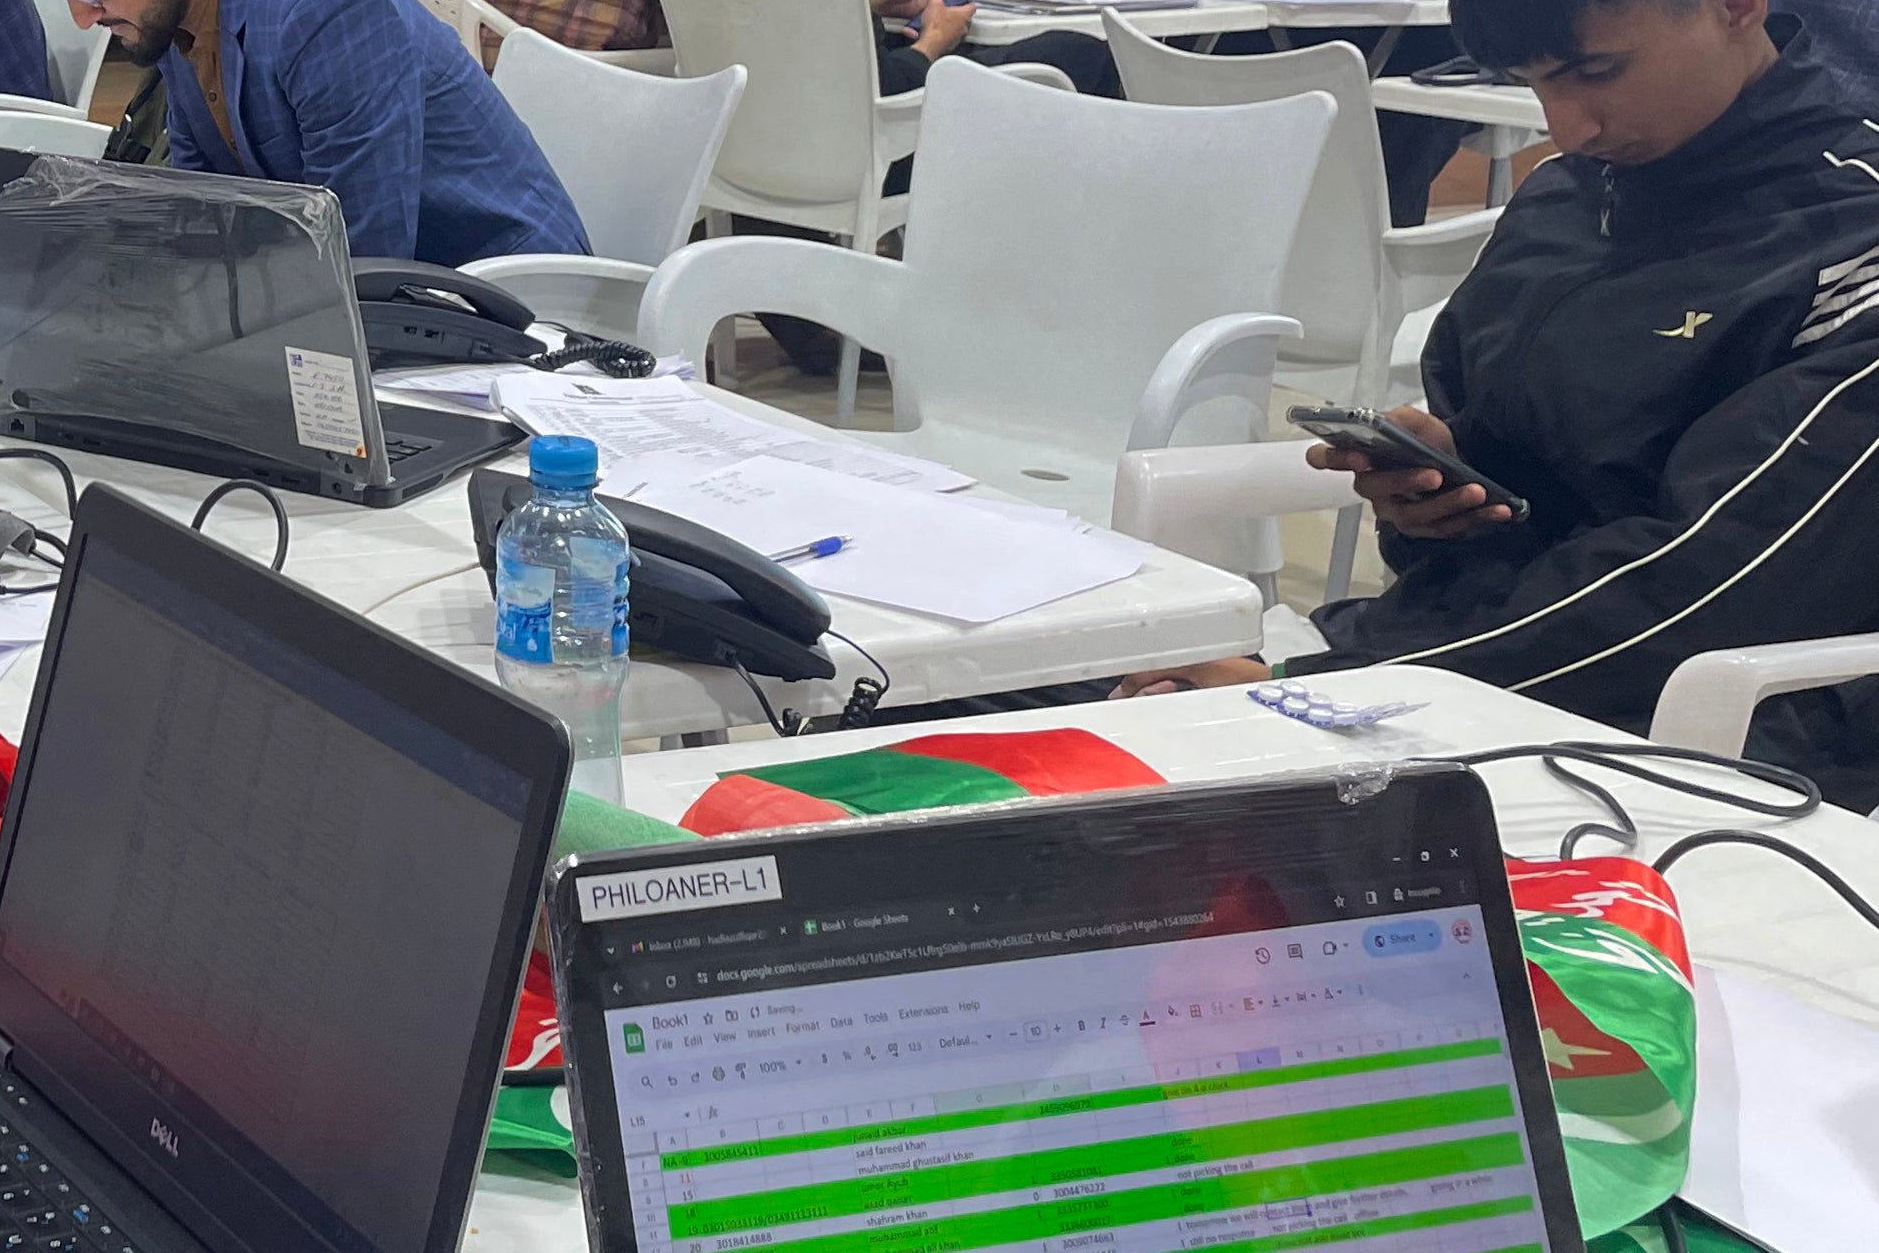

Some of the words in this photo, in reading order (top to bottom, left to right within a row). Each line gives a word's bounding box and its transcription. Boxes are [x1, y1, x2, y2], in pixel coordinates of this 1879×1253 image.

[591, 866, 768, 911] PHILOANER-L1
[651, 1012, 688, 1030] Book1
[785, 1019, 820, 1033] Format
[830, 1015, 853, 1028] Data
[864, 1011, 888, 1023] Tools
[898, 1003, 949, 1019] Extensions
[958, 999, 981, 1012] Help
[150, 1116, 179, 1158] DELL
[904, 1139, 926, 1150] khan
[905, 1208, 928, 1220] khan
